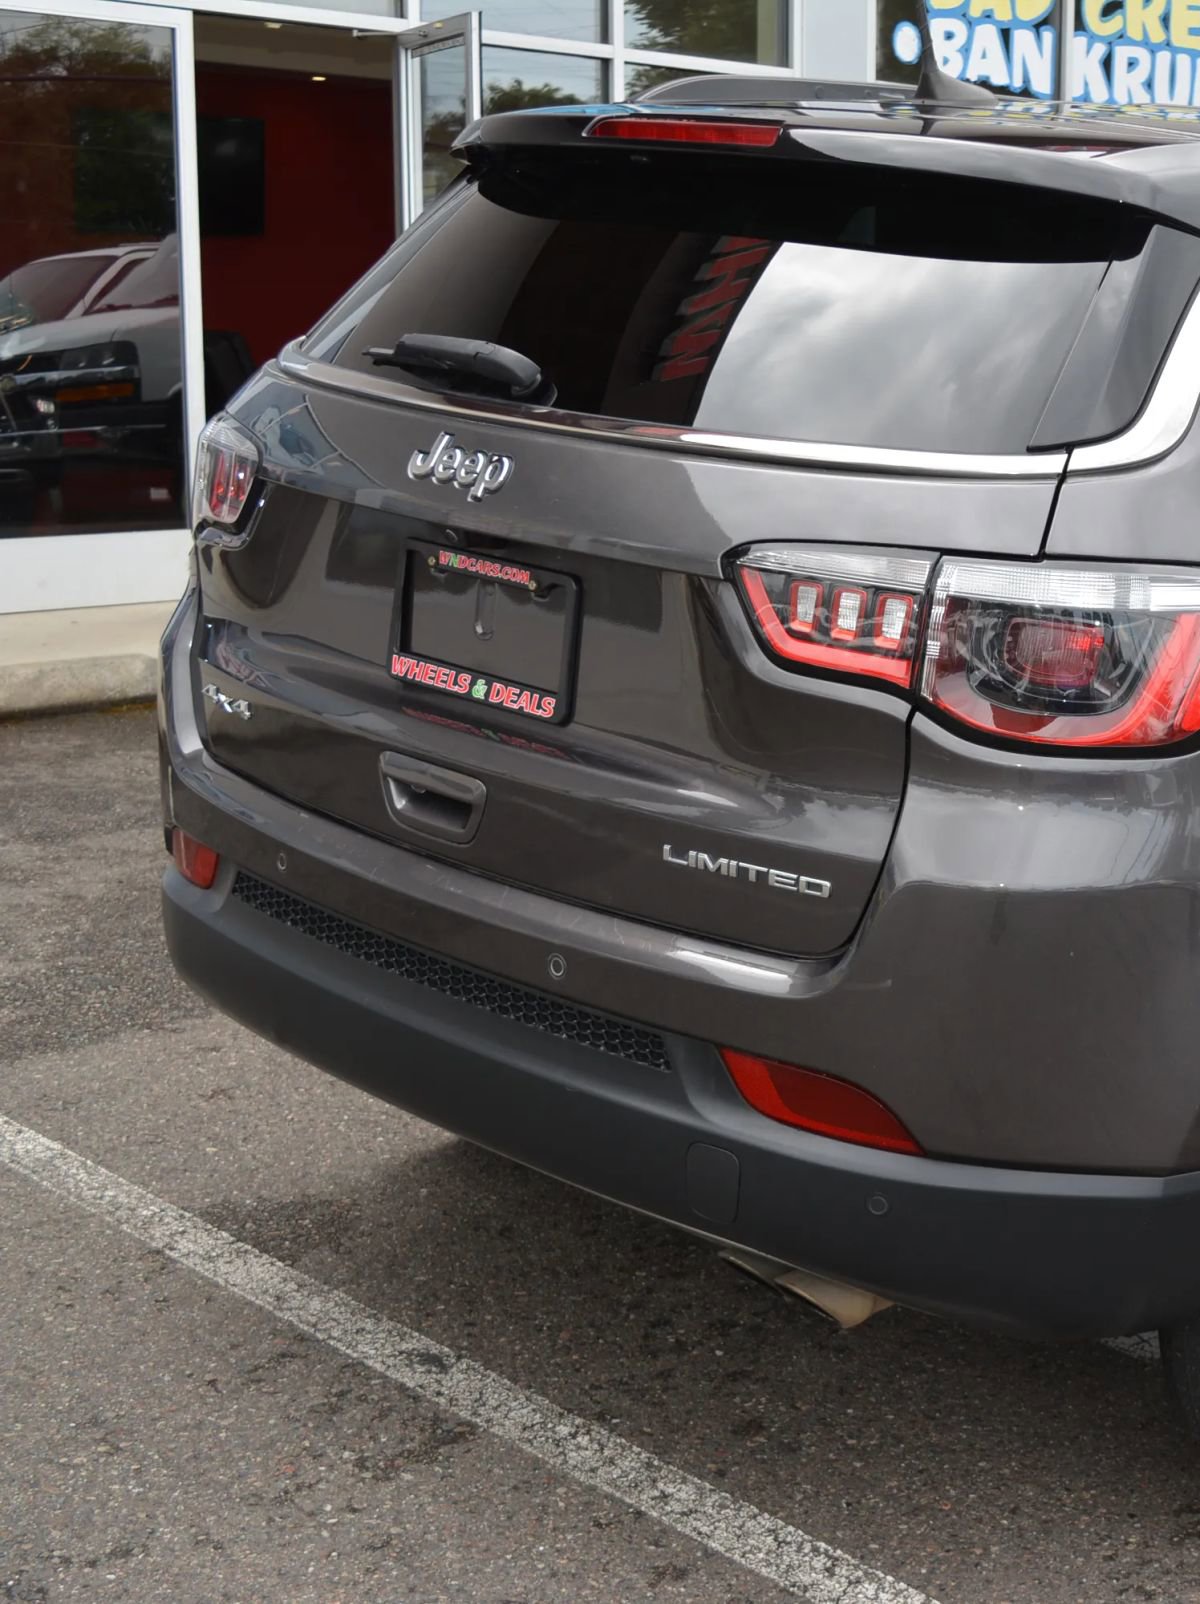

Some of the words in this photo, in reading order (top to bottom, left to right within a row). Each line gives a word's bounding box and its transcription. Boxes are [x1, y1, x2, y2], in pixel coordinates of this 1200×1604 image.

[407, 431, 514, 502] Jeep
[438, 550, 531, 585] WNDCARS.COM
[390, 655, 472, 694] WHEELS
[472, 679, 487, 700] &
[489, 682, 556, 718] DEALS
[663, 844, 832, 898] LIMITED
